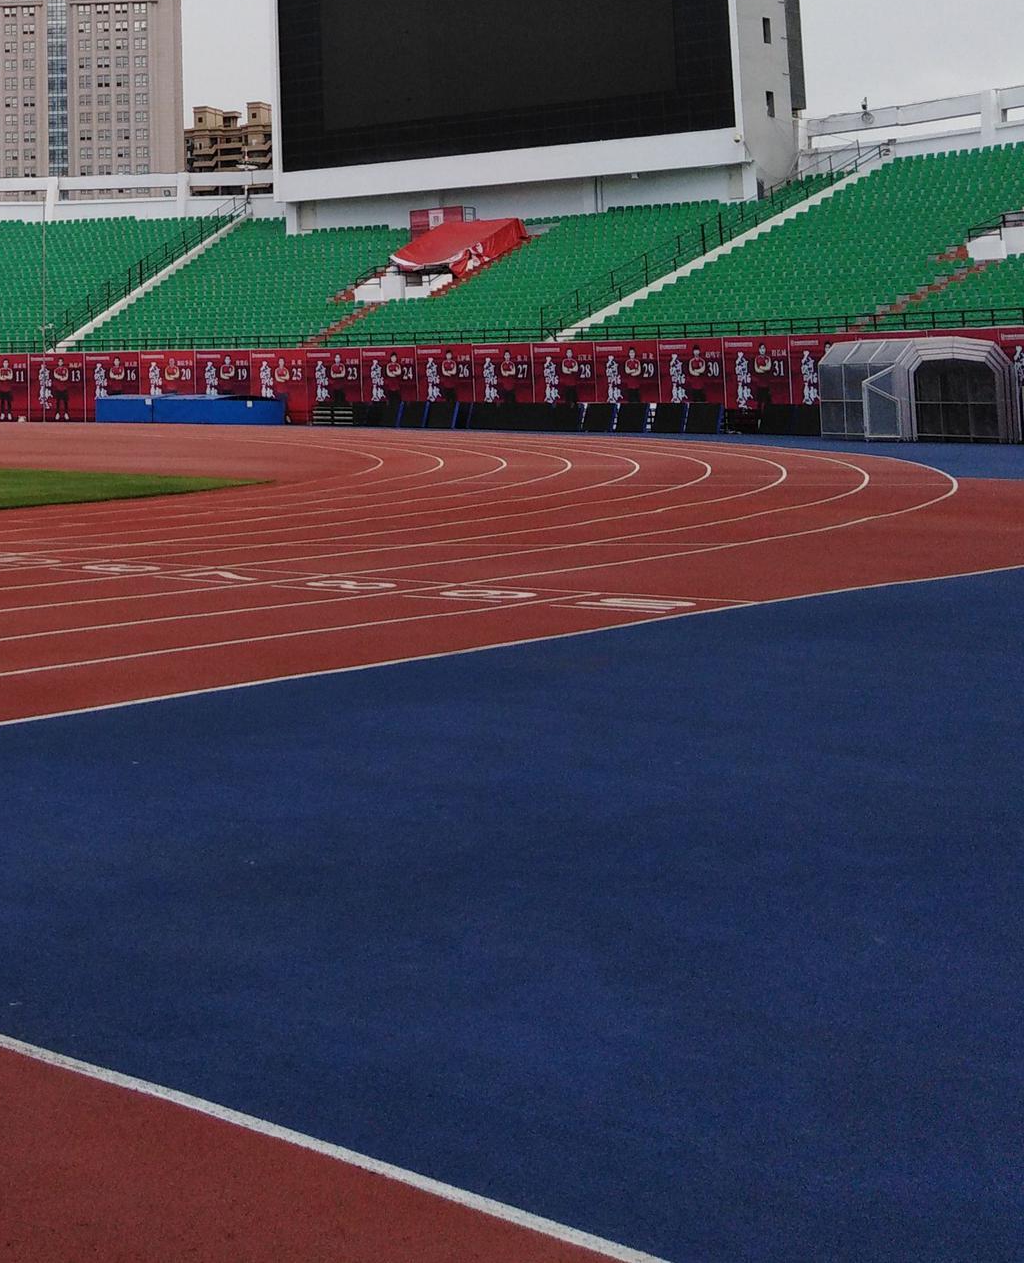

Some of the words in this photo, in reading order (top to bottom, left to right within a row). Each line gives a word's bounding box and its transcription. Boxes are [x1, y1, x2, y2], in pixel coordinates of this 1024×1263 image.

[292, 368, 302, 380] 25
[348, 368, 357, 379] 23
[403, 367, 413, 379] 24
[459, 365, 469, 377] 26
[518, 365, 528, 377] 27
[580, 365, 591, 378] 28
[643, 364, 654, 377] 29
[708, 362, 719, 376] 30
[774, 361, 784, 376] 31
[16, 371, 24, 381] 11
[72, 370, 80, 381] 13
[127, 370, 136, 380] 16
[181, 369, 191, 380] 20
[238, 369, 247, 380] 19
[180, 571, 258, 581] 7
[305, 580, 397, 590] 8
[438, 589, 538, 599] 9
[574, 598, 697, 610] 10
